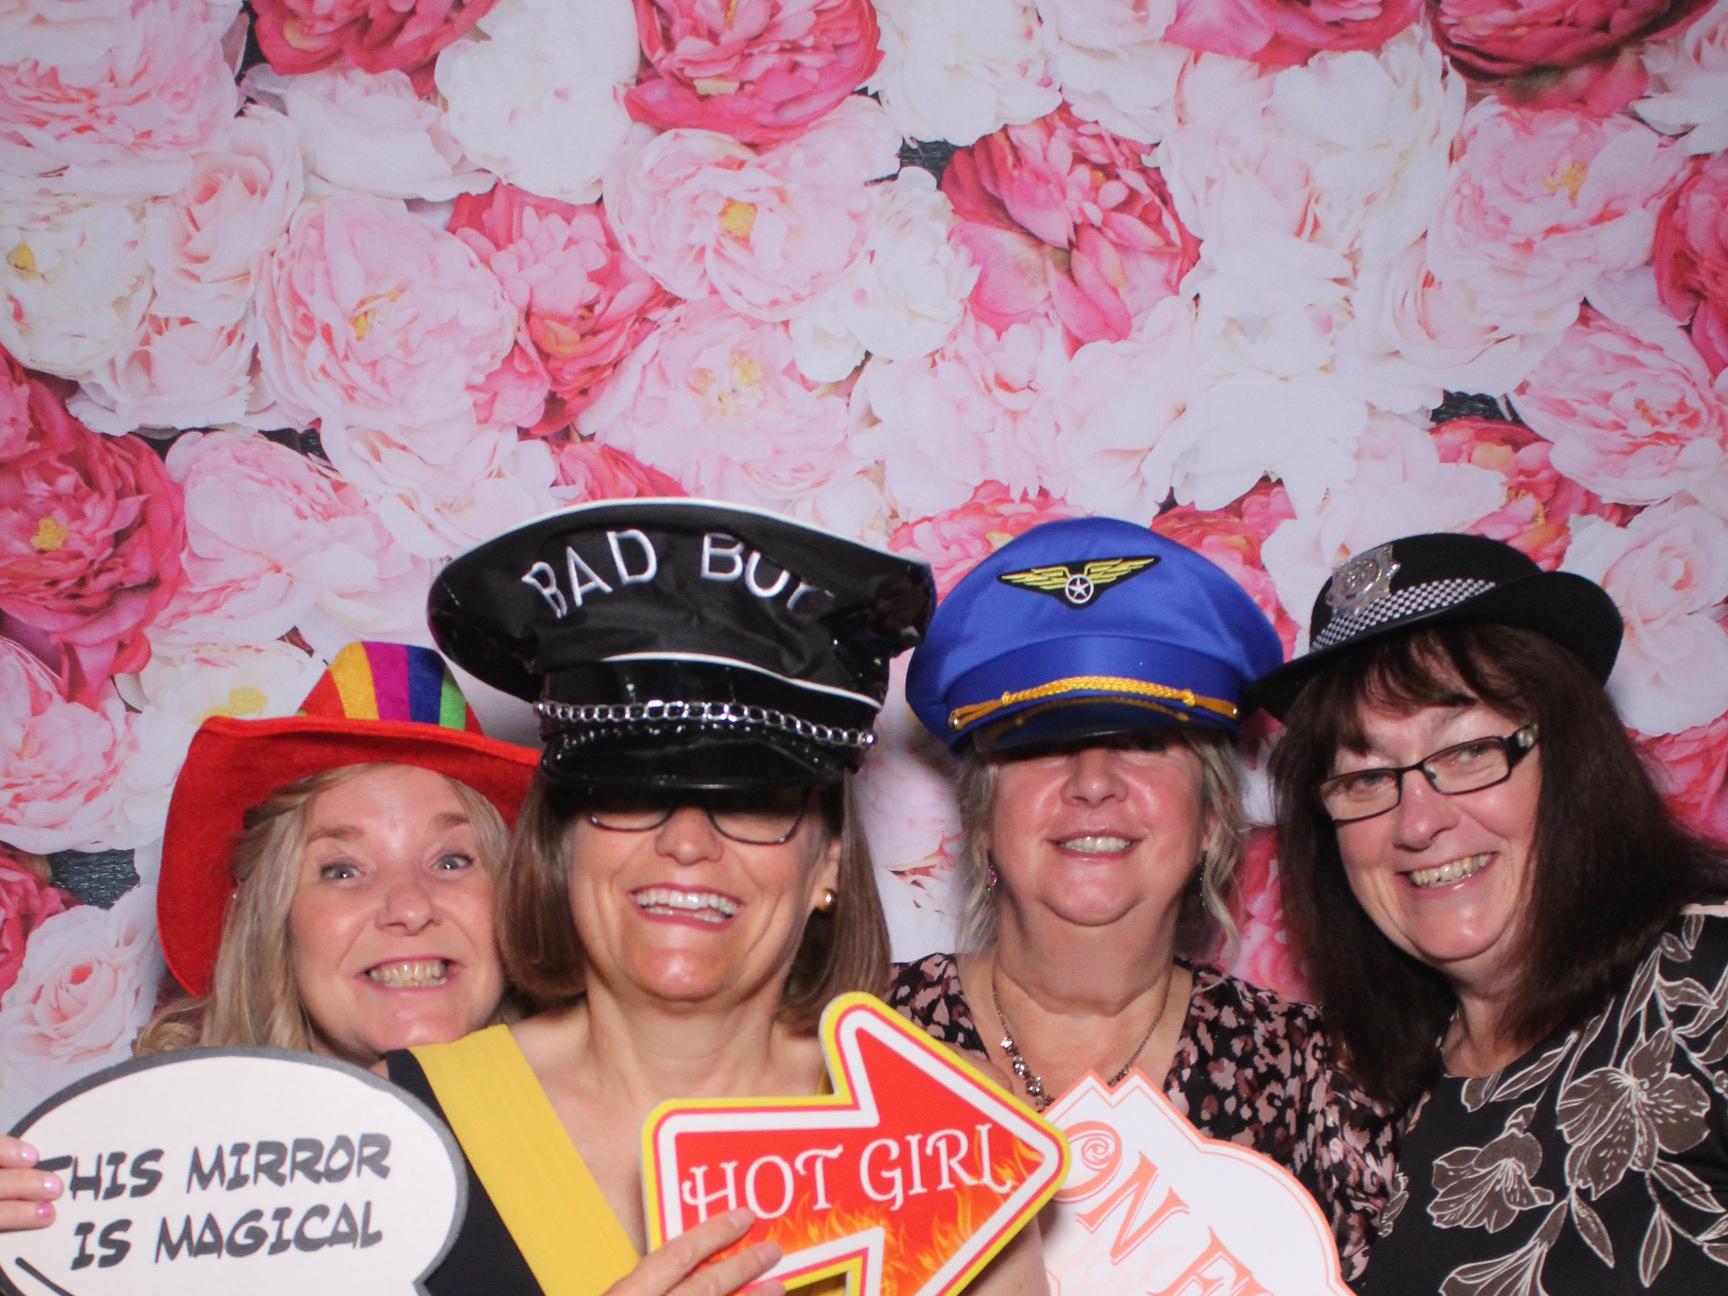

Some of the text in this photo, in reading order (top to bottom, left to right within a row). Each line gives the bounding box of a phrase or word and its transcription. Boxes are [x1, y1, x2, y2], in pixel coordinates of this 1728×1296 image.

[521, 528, 657, 619] BAD
[186, 1132, 391, 1194] MIRROR
[682, 1123, 1012, 1223] HOT GIRL
[1053, 1120, 1190, 1265] ON
[70, 1200, 383, 1271] IS MAGICAL
